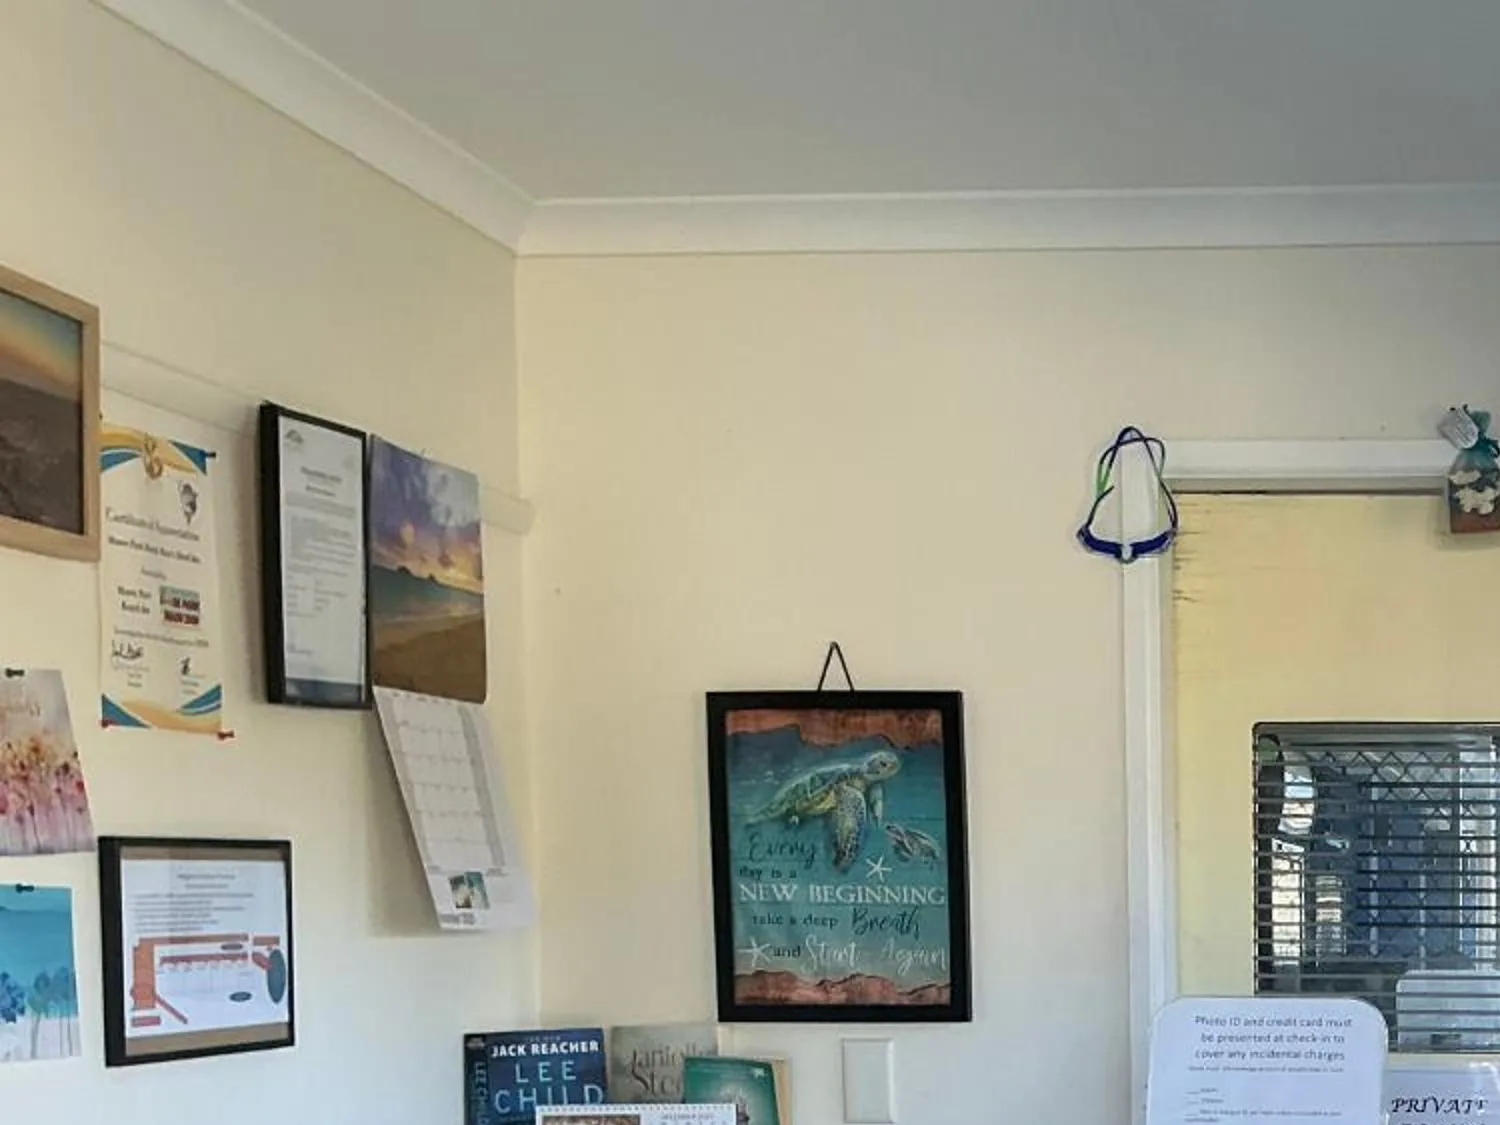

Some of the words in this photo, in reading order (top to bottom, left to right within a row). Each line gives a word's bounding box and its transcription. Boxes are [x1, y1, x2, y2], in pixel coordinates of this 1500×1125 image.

[749, 831, 817, 869] Every
[771, 866, 783, 878] is
[789, 870, 797, 878] a
[739, 883, 799, 902] NEW
[808, 884, 946, 905] BEGINNING
[752, 911, 783, 925] take
[789, 916, 797, 925] a
[802, 912, 840, 930] deep
[851, 905, 920, 941] Breath
[773, 944, 801, 958] and
[804, 934, 859, 970] Start
[1194, 1015, 1227, 1027] Photo
[1229, 1016, 1242, 1027] ID
[1243, 1016, 1265, 1028] and
[1265, 1016, 1298, 1028] credit
[1299, 1017, 1323, 1028] card
[1325, 1018, 1352, 1028] must
[1200, 1032, 1215, 1043] be
[1216, 1032, 1271, 1045] presented
[1273, 1033, 1284, 1044] at
[1332, 1034, 1345, 1043] to
[490, 1043, 528, 1059] JACK
[530, 1039, 600, 1056] REACHER
[1194, 1049, 1225, 1060] cover
[1227, 1051, 1247, 1061] any
[1249, 1048, 1301, 1060] incidental
[1303, 1048, 1345, 1063] charges
[514, 1060, 578, 1084] LEE
[494, 1084, 605, 1115] CHILD
[1391, 1095, 1488, 1115] PRIVATE
